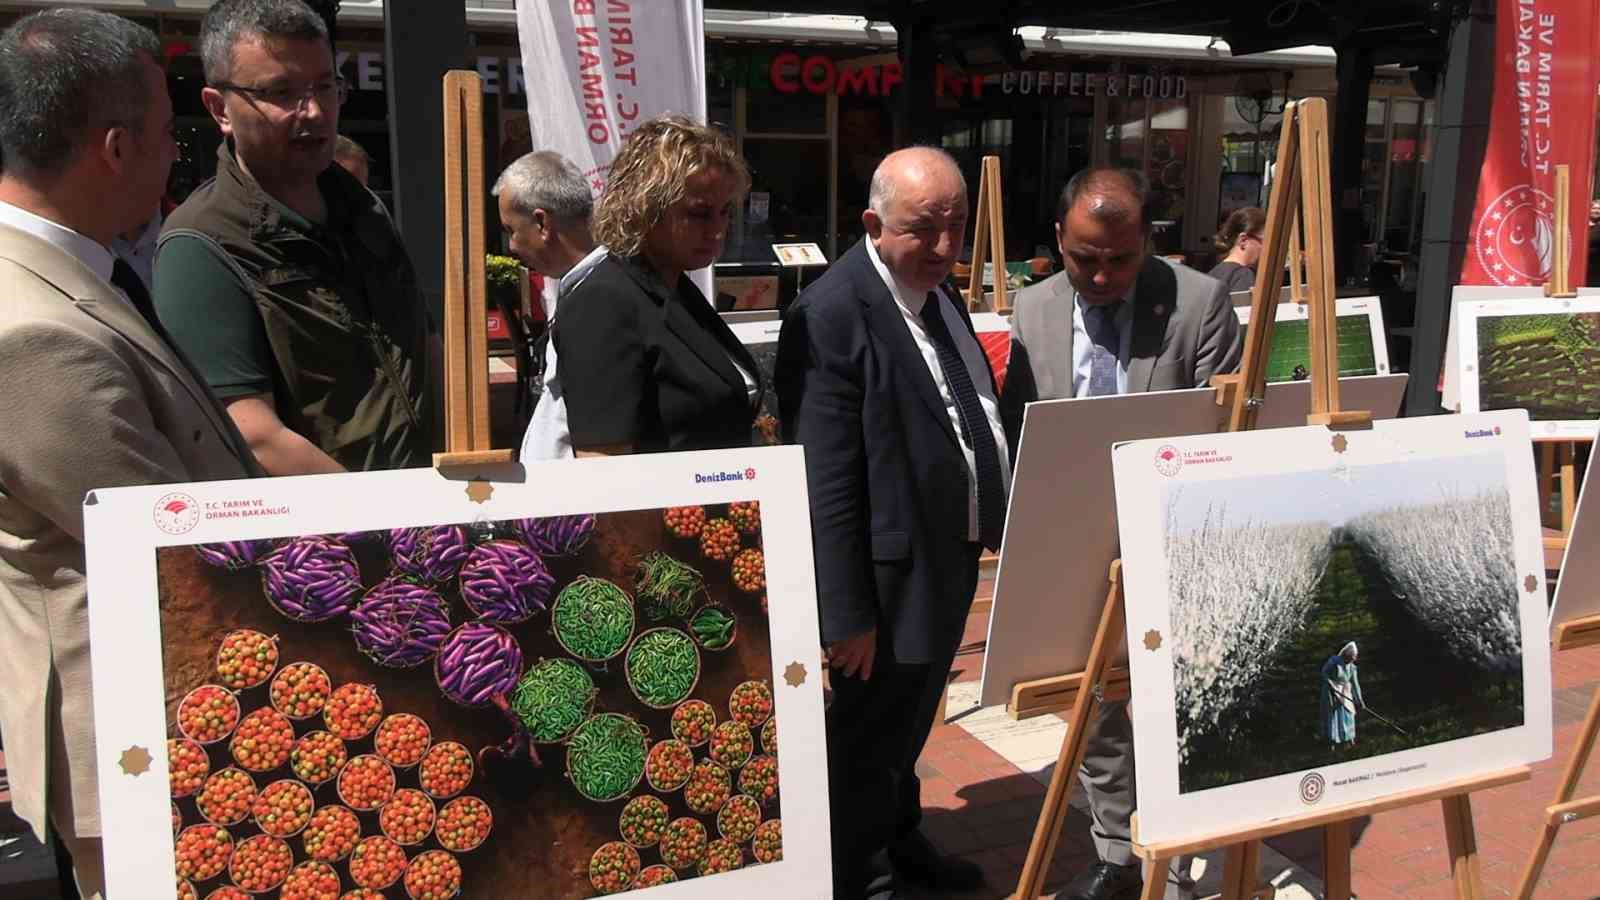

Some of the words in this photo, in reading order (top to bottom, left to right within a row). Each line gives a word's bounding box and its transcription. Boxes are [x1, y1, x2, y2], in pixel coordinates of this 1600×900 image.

[1002, 71, 1096, 96] COFFEE
[1106, 74, 1118, 96] &
[1127, 74, 1187, 98] FOOD
[695, 471, 743, 483] DenizBank
[222, 500, 251, 509] TARIM
[253, 499, 264, 507] VE
[206, 511, 240, 520] ORMAN
